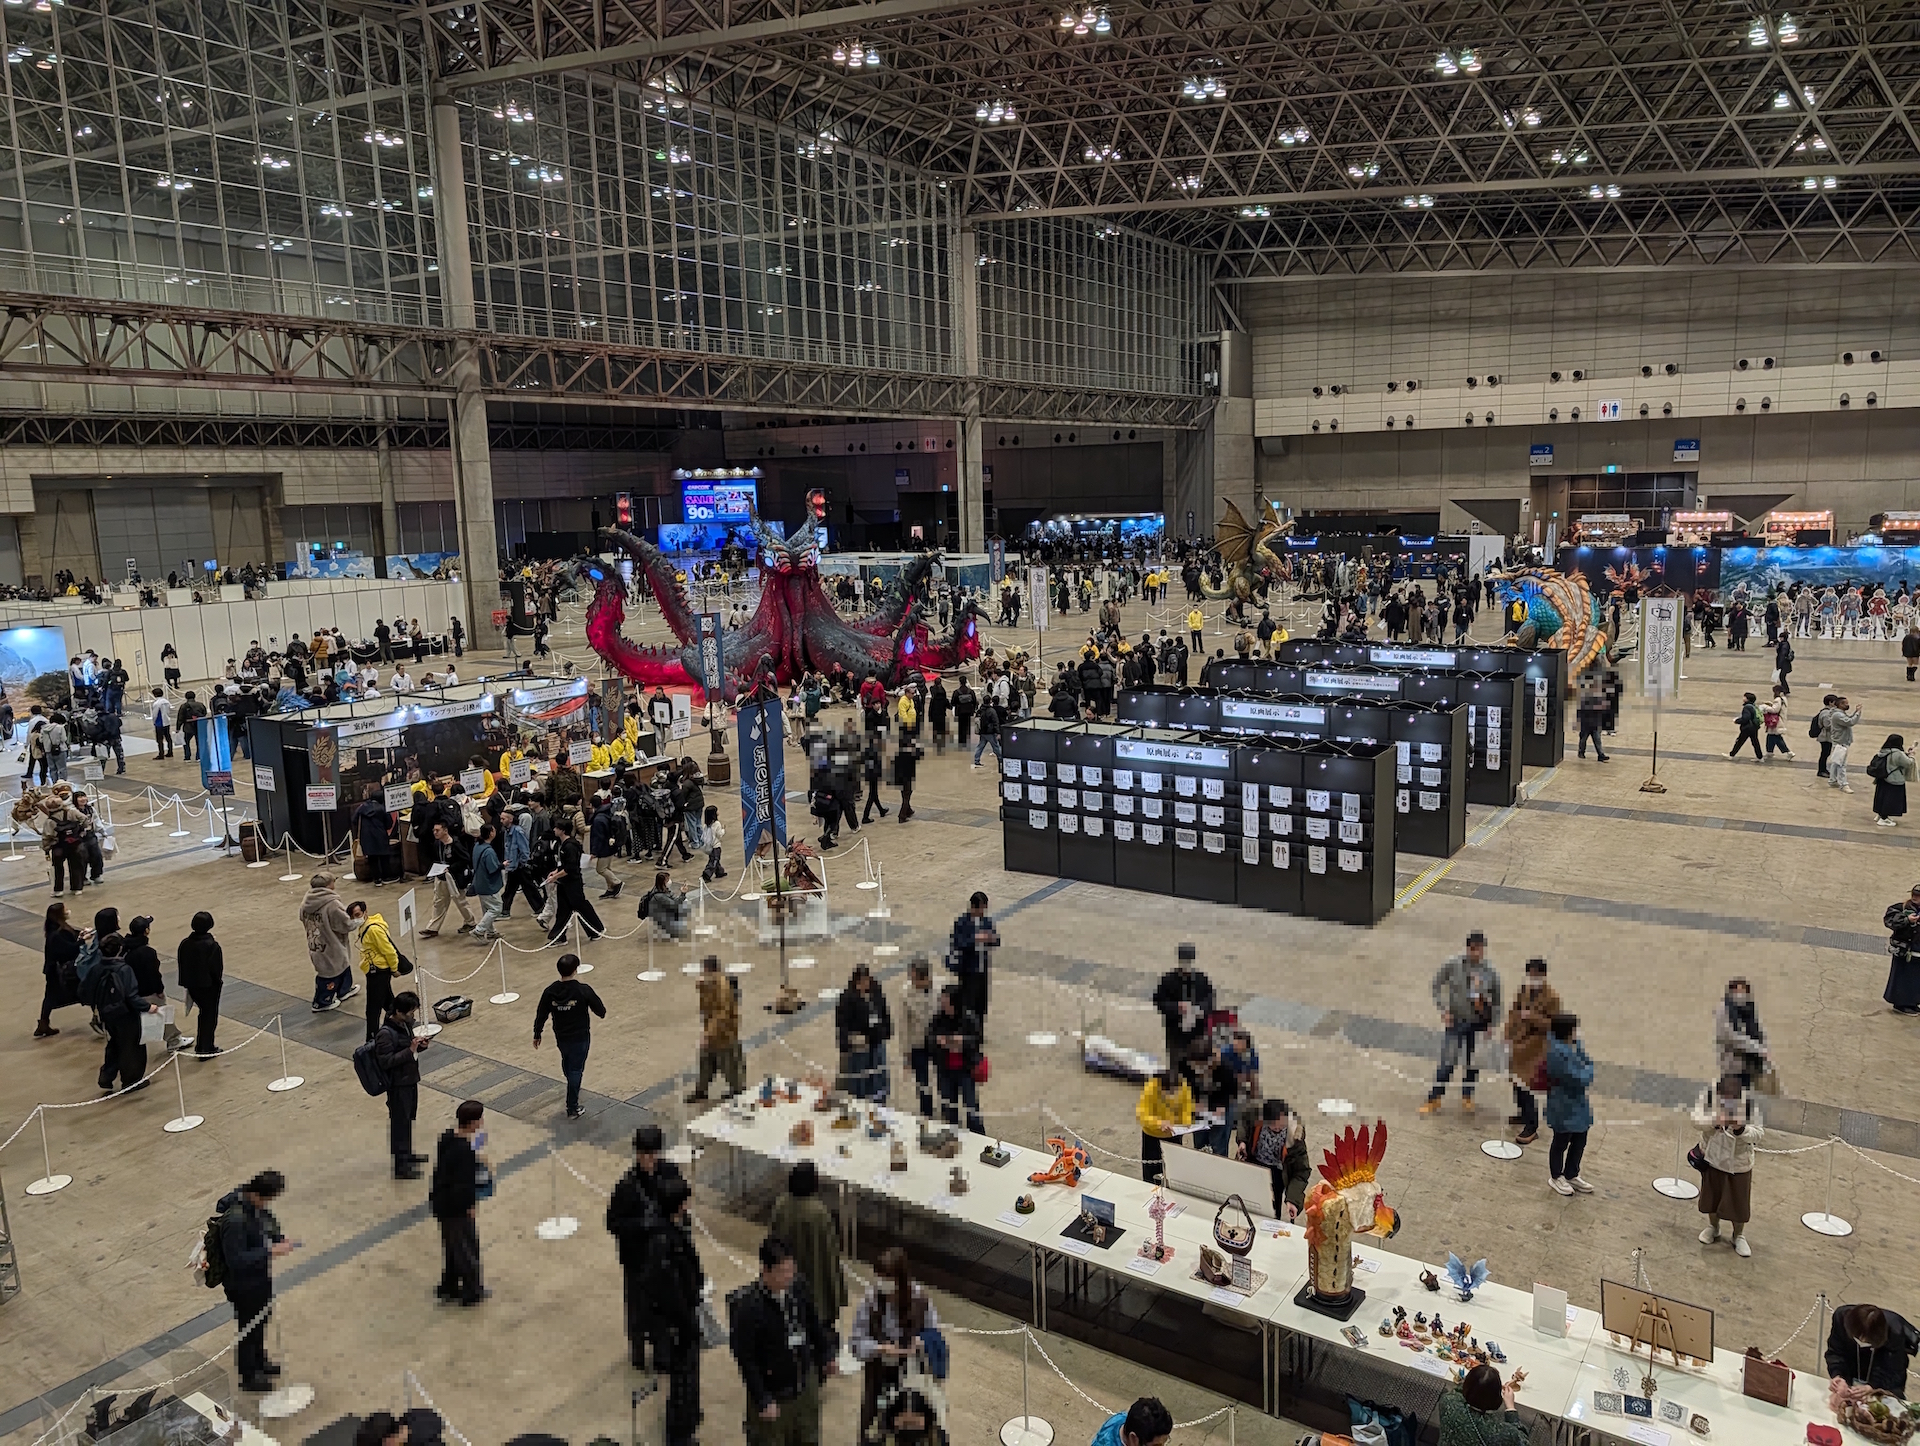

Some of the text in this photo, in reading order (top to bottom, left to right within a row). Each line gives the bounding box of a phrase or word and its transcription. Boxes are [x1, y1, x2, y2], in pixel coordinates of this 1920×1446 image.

[1544, 446, 1550, 454] 2
[1690, 441, 1696, 449] 2
[685, 495, 714, 505] SALE
[702, 636, 720, 689] 案内所
[424, 701, 482, 718] スタンプラリー引換所
[1249, 707, 1280, 717] 原画展示
[353, 720, 376, 731] 案内所
[1146, 747, 1180, 758] 原画展示
